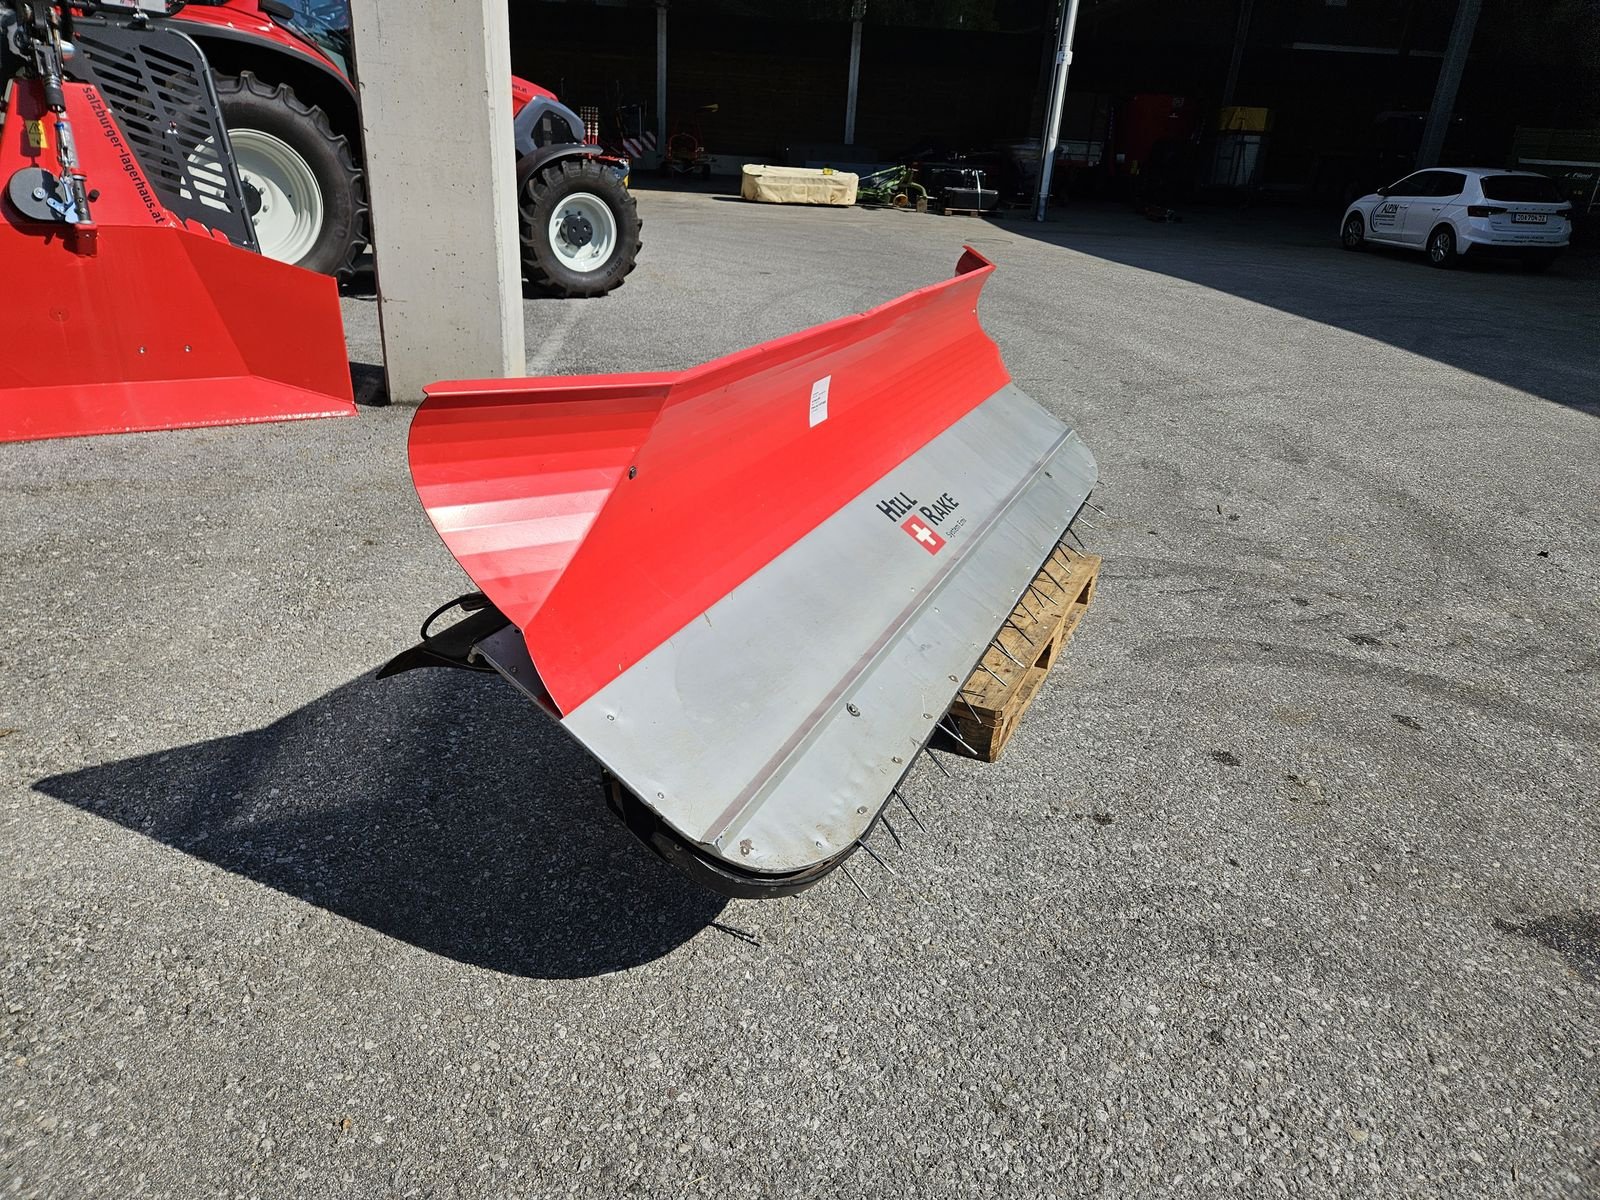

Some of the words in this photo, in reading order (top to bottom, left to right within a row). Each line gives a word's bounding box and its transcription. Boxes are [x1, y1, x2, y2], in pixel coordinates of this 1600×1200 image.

[83, 87, 165, 223] salzburger-lagerhaus.at
[876, 492, 917, 522] HILL
[919, 493, 959, 526] RAKE
